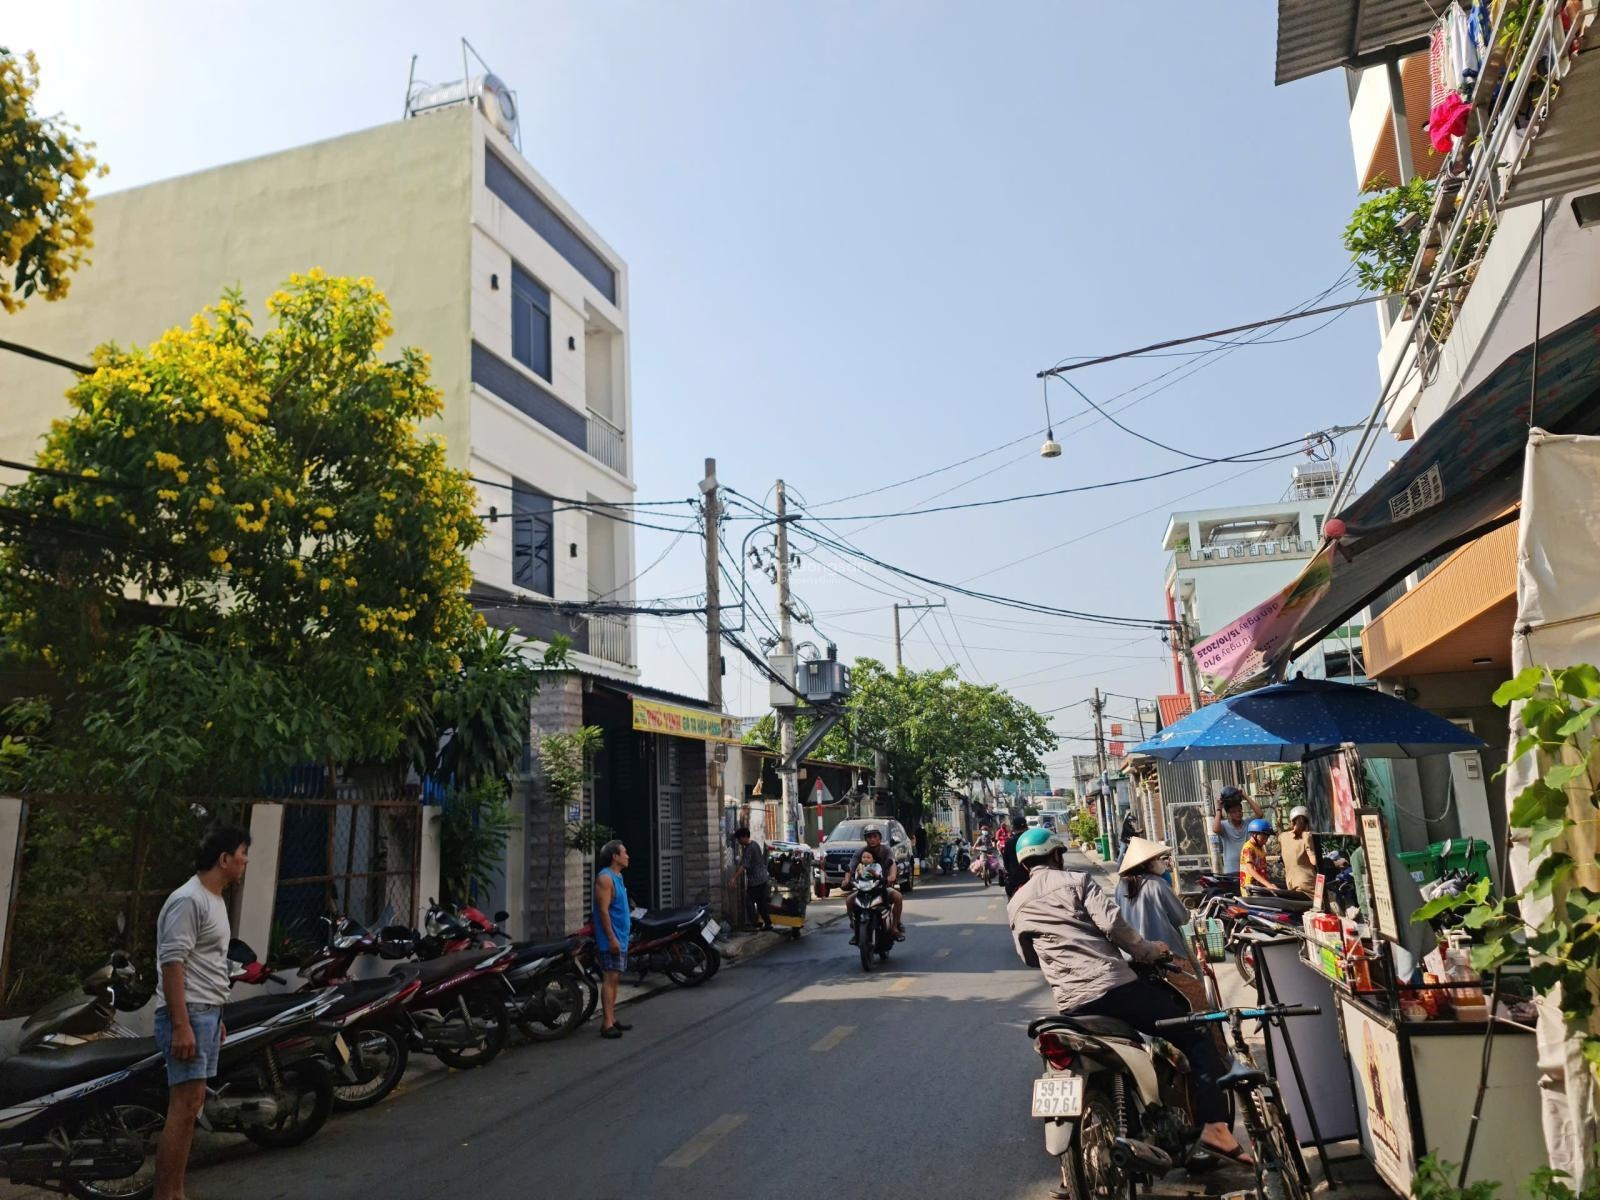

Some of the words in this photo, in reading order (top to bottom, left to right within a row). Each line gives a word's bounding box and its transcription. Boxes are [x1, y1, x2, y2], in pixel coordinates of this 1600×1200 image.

[1239, 614, 1261, 633] ngày
[1197, 629, 1241, 658] 15/10/2025
[1221, 642, 1242, 657] ngày
[1203, 654, 1222, 669] 9/10
[1040, 1081, 1074, 1097] 59-F1
[1035, 1097, 1078, 1114] 297.64
